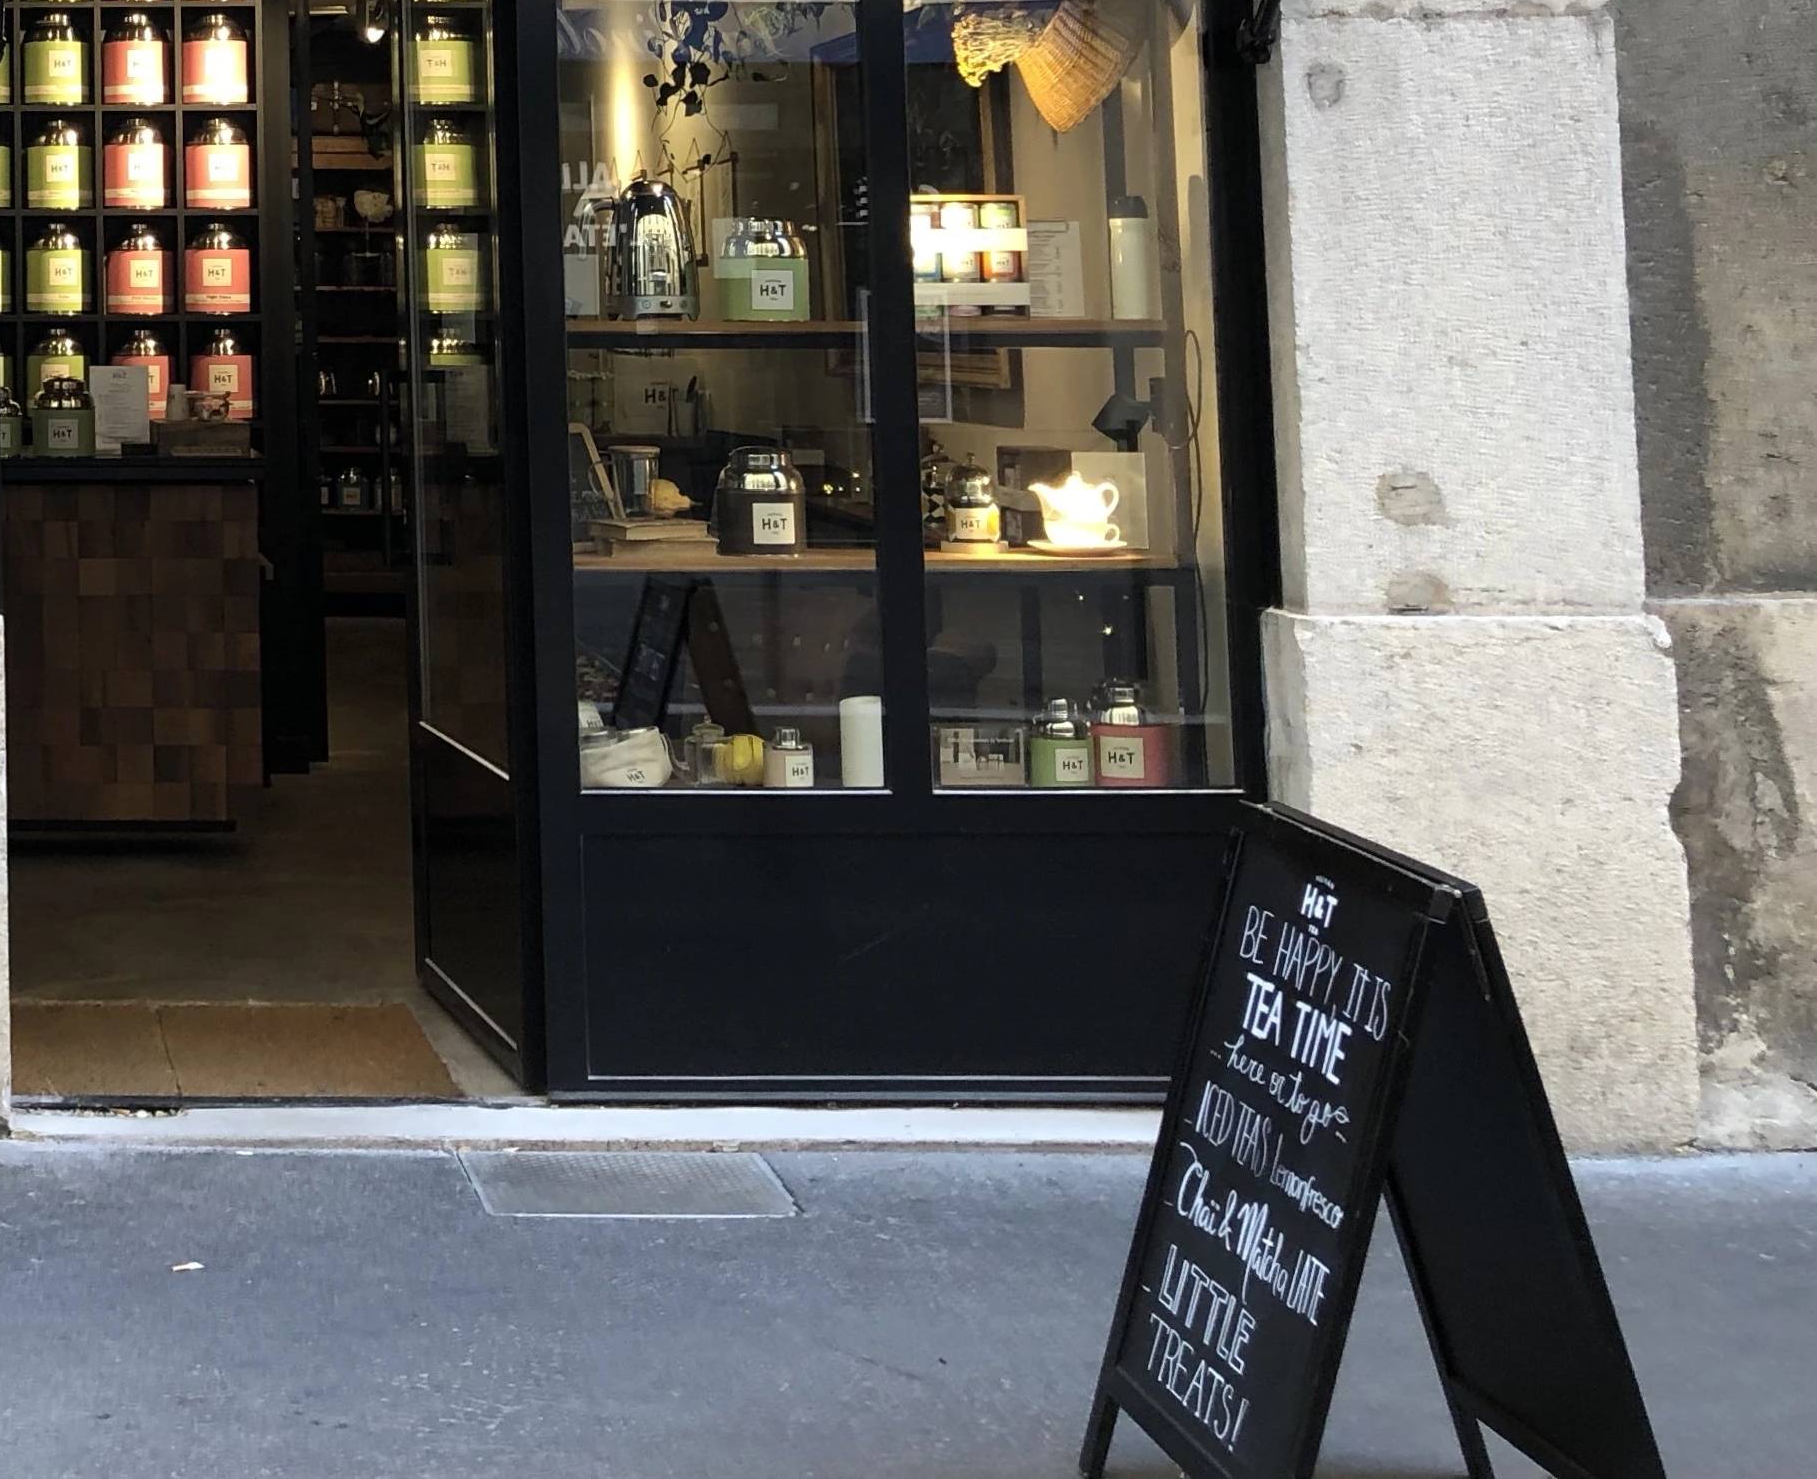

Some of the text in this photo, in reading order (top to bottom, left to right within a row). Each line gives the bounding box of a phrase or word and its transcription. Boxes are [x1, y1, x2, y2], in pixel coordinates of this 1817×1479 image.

[208, 268, 226, 277] H&T
[759, 284, 787, 297] H&T
[214, 374, 232, 383] H&T
[53, 429, 72, 438] H&T
[761, 518, 787, 530] H&T
[961, 518, 981, 529] H&T
[1108, 751, 1135, 765] H&T
[792, 766, 810, 777] H&T
[1062, 760, 1083, 770] H&T
[1300, 883, 1339, 929] H&T
[1239, 905, 1275, 965] BE
[1364, 975, 1392, 1042] IS
[1242, 971, 1353, 1086] TEA TIME
[1224, 1034, 1265, 1084] here
[1269, 1072, 1286, 1103] or
[1285, 1071, 1310, 1114] to
[1195, 1080, 1235, 1147] ICED
[1231, 1101, 1273, 1178] TEAS
[1217, 1190, 1236, 1251] &
[1236, 1201, 1289, 1305] Matcha
[1286, 1249, 1330, 1326] LATTE
[1158, 1244, 1256, 1376] LITTLE
